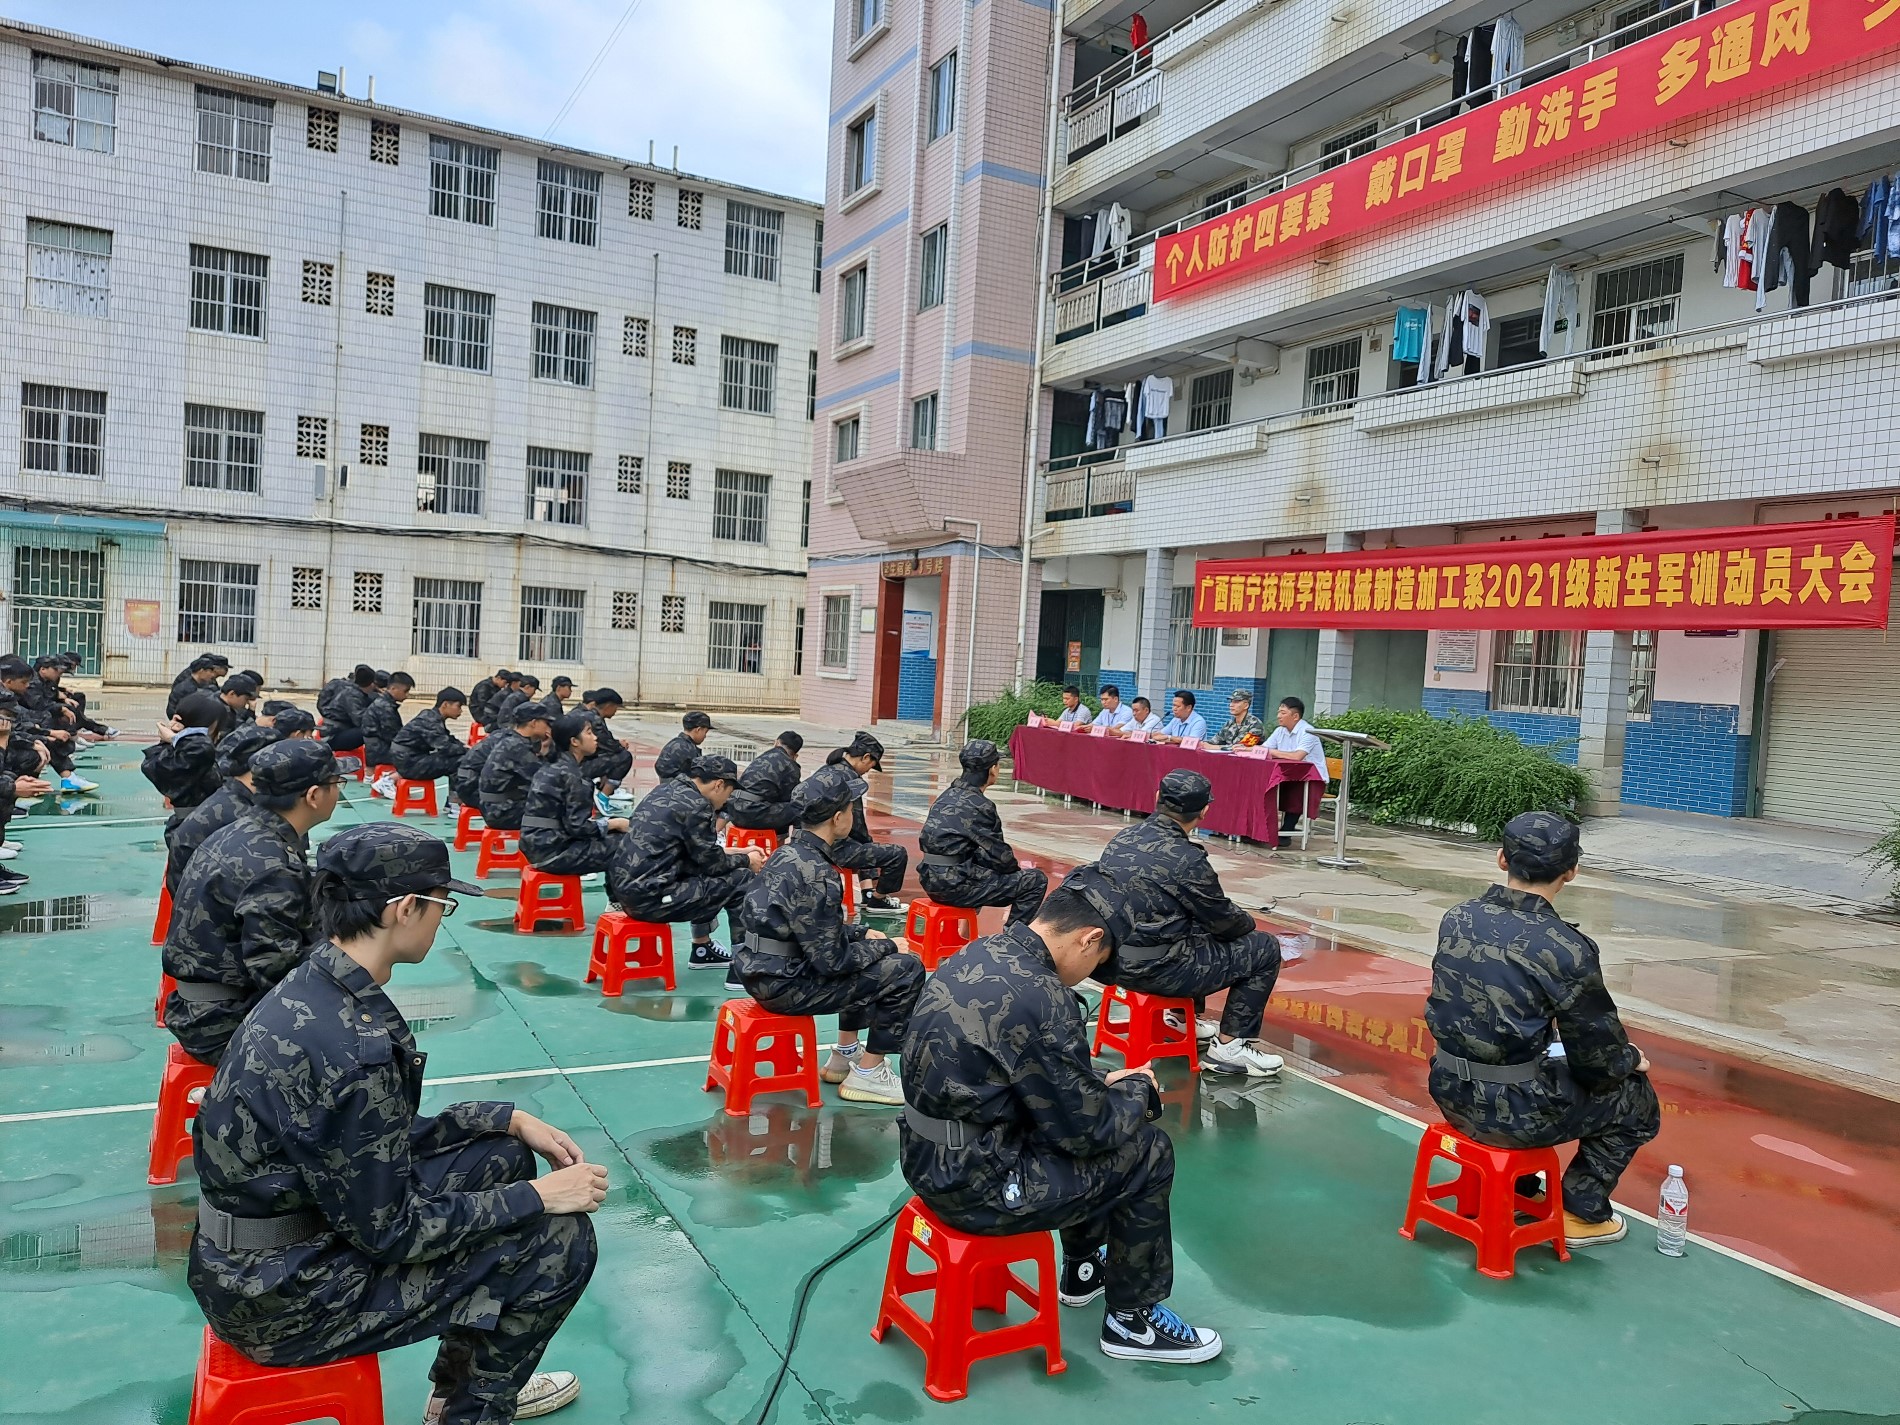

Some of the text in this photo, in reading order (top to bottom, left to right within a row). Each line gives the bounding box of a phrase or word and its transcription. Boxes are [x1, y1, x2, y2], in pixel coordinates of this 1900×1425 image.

[1165, 0, 1811, 285] 个人防护四要素 戴口罩 勤洗手 多通风
[1198, 541, 1876, 612] 广西南宁技师学院机械制造加工系2021级新生军训动员大会
